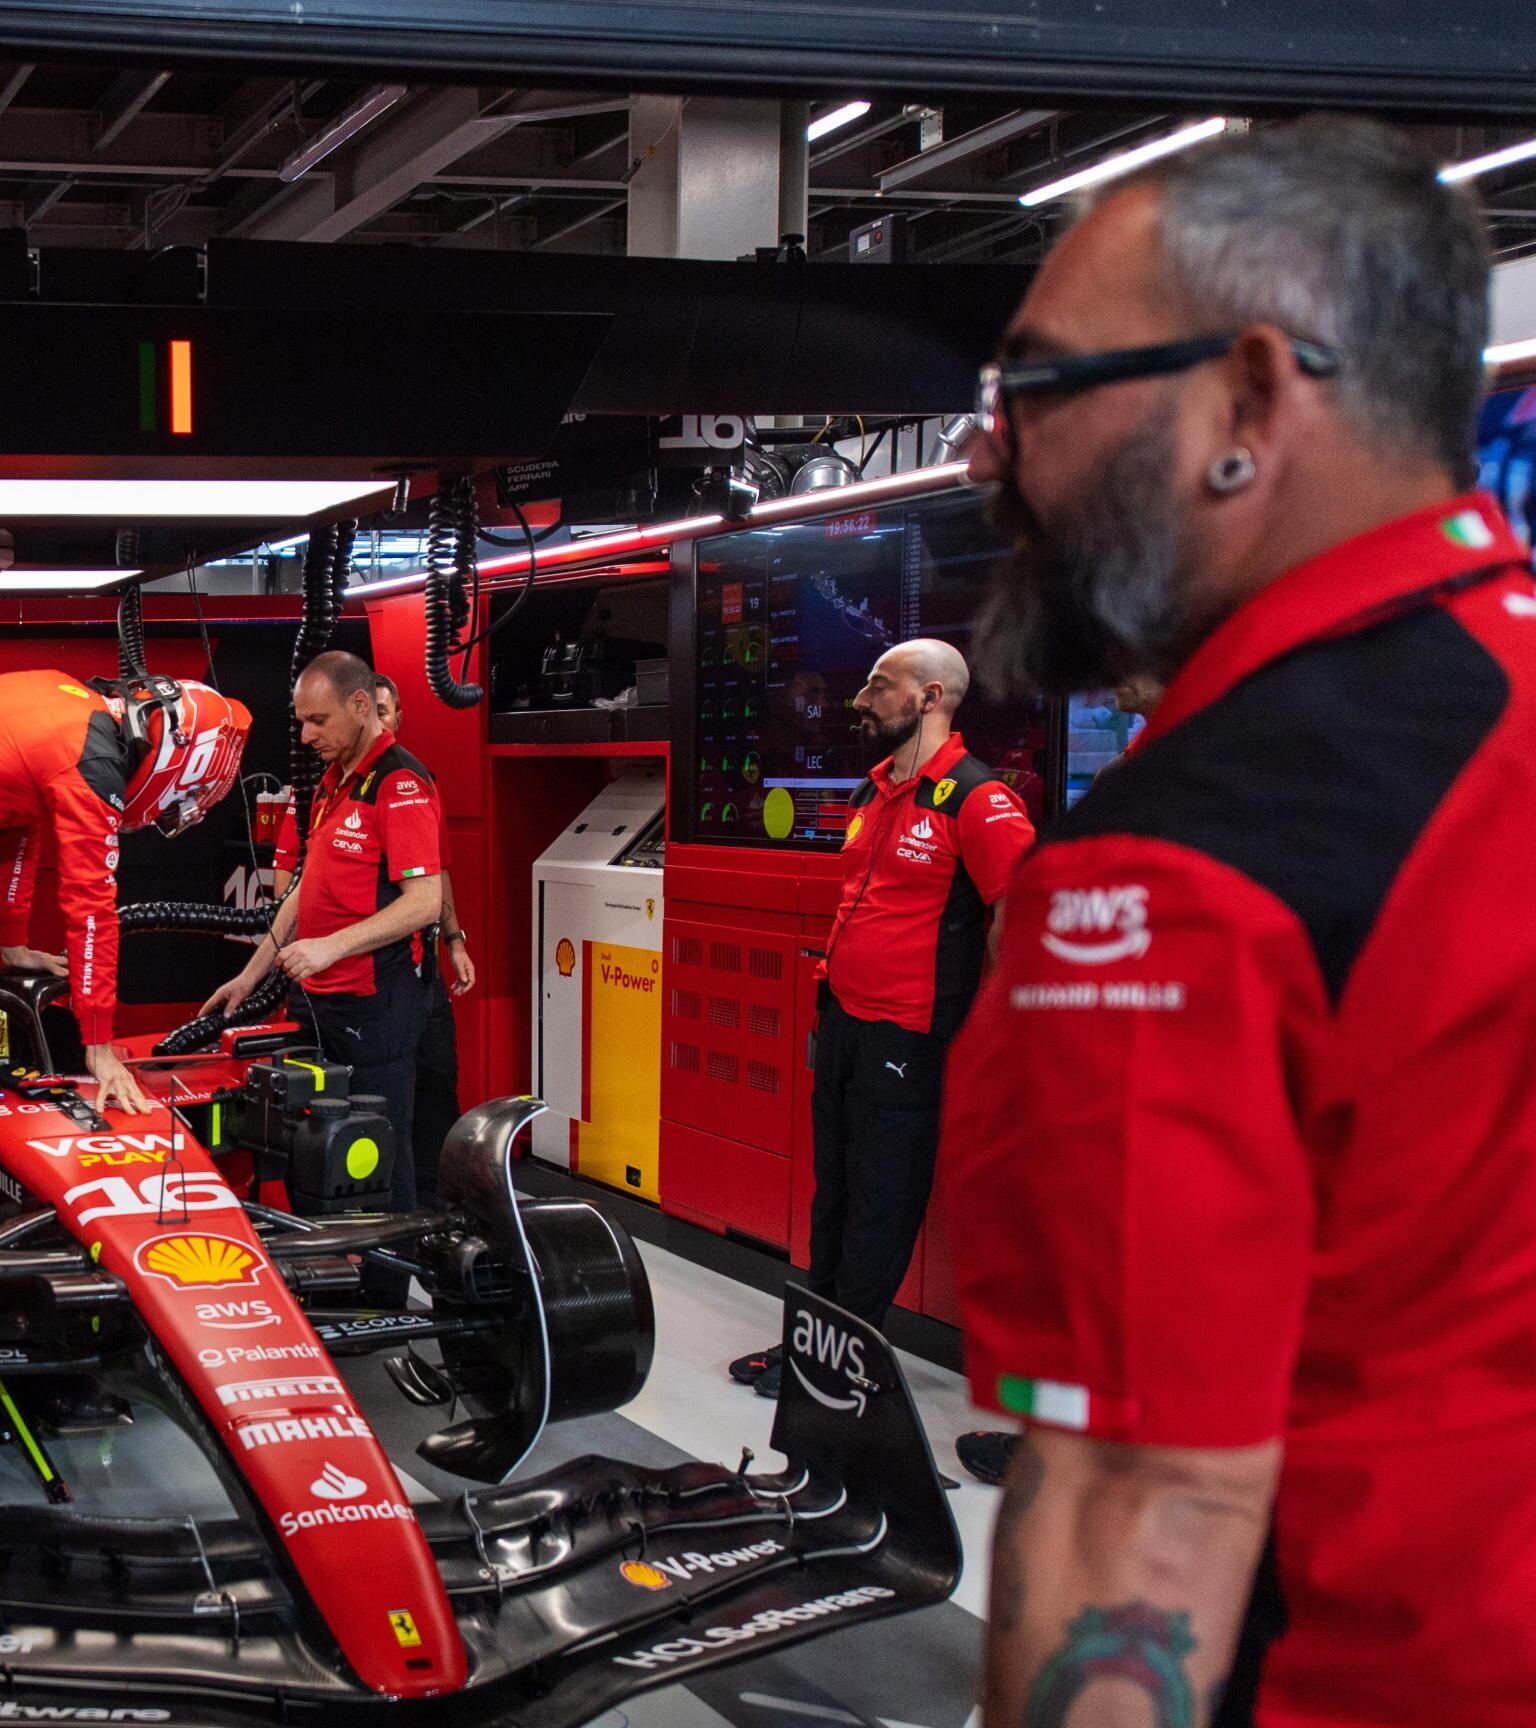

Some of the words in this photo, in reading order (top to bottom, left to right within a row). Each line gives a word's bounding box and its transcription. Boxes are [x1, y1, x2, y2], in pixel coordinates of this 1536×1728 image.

[507, 460, 560, 475] SCUDERIA
[507, 471, 552, 484] FERRARI
[508, 483, 529, 493] APP
[828, 516, 870, 536] 19:56:22
[807, 705, 822, 719] SAI
[807, 755, 823, 769] LEC
[396, 780, 418, 791] aws
[335, 827, 368, 840] Santander
[898, 835, 938, 851] Santander
[7, 877, 20, 903] MILLE
[82, 962, 93, 995] MILLE
[601, 963, 655, 993] V-Power
[26, 1133, 185, 1157] VGW
[77, 1150, 166, 1167] PLAY
[64, 1171, 243, 1226] 16
[195, 1300, 273, 1320] aws
[338, 1315, 429, 1332] ECOPOL
[228, 1342, 320, 1363] Palantir
[793, 1310, 865, 1380] aws
[216, 1376, 346, 1404] PIRELLI
[238, 1416, 374, 1450] MAHLE
[280, 1499, 415, 1537] Santander
[652, 1539, 785, 1581] V-Power
[612, 1584, 896, 1670] HCLSoftware
